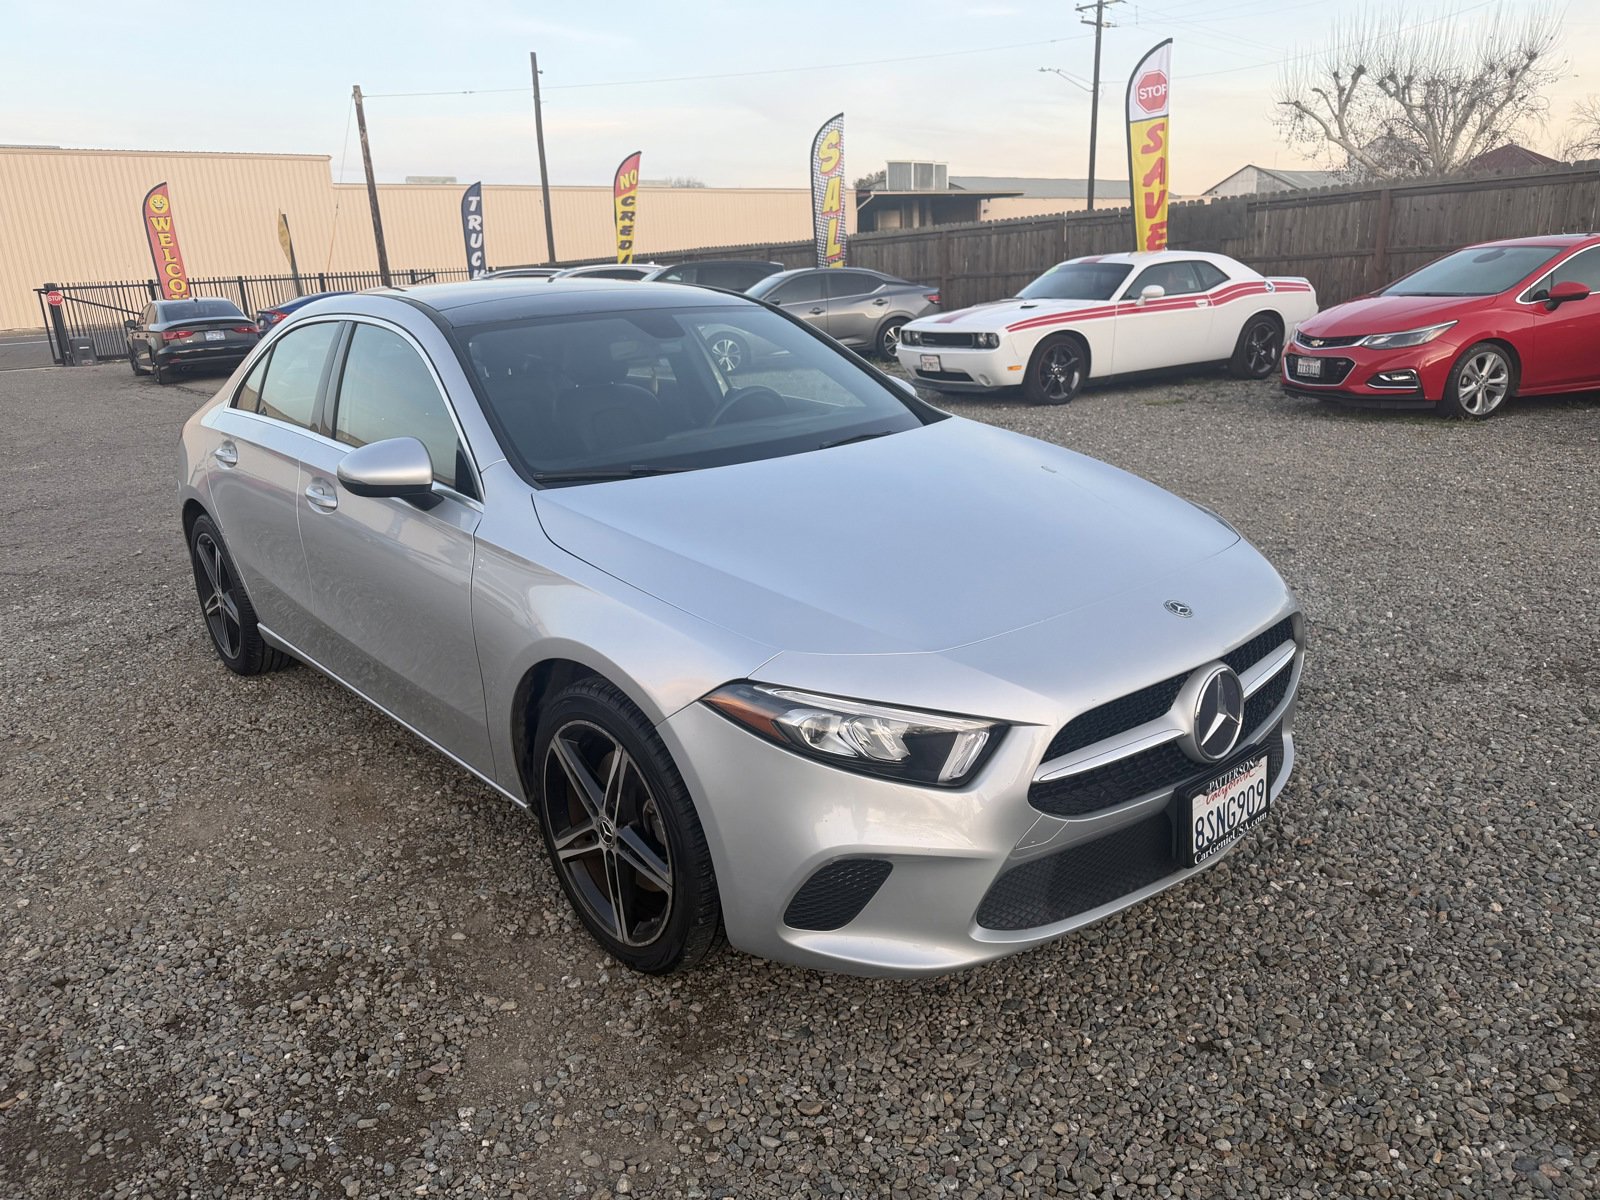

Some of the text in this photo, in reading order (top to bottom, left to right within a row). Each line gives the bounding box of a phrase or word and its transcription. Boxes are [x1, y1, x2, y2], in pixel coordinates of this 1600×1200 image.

[1139, 84, 1167, 100] STOP
[619, 168, 638, 190] NO
[818, 128, 846, 268] SAL
[1141, 122, 1167, 253] SAVE
[1208, 757, 1257, 791] PATTERSON
[1194, 778, 1265, 851] 8SNG909
[1194, 812, 1268, 865] CarGenieUSA.com
